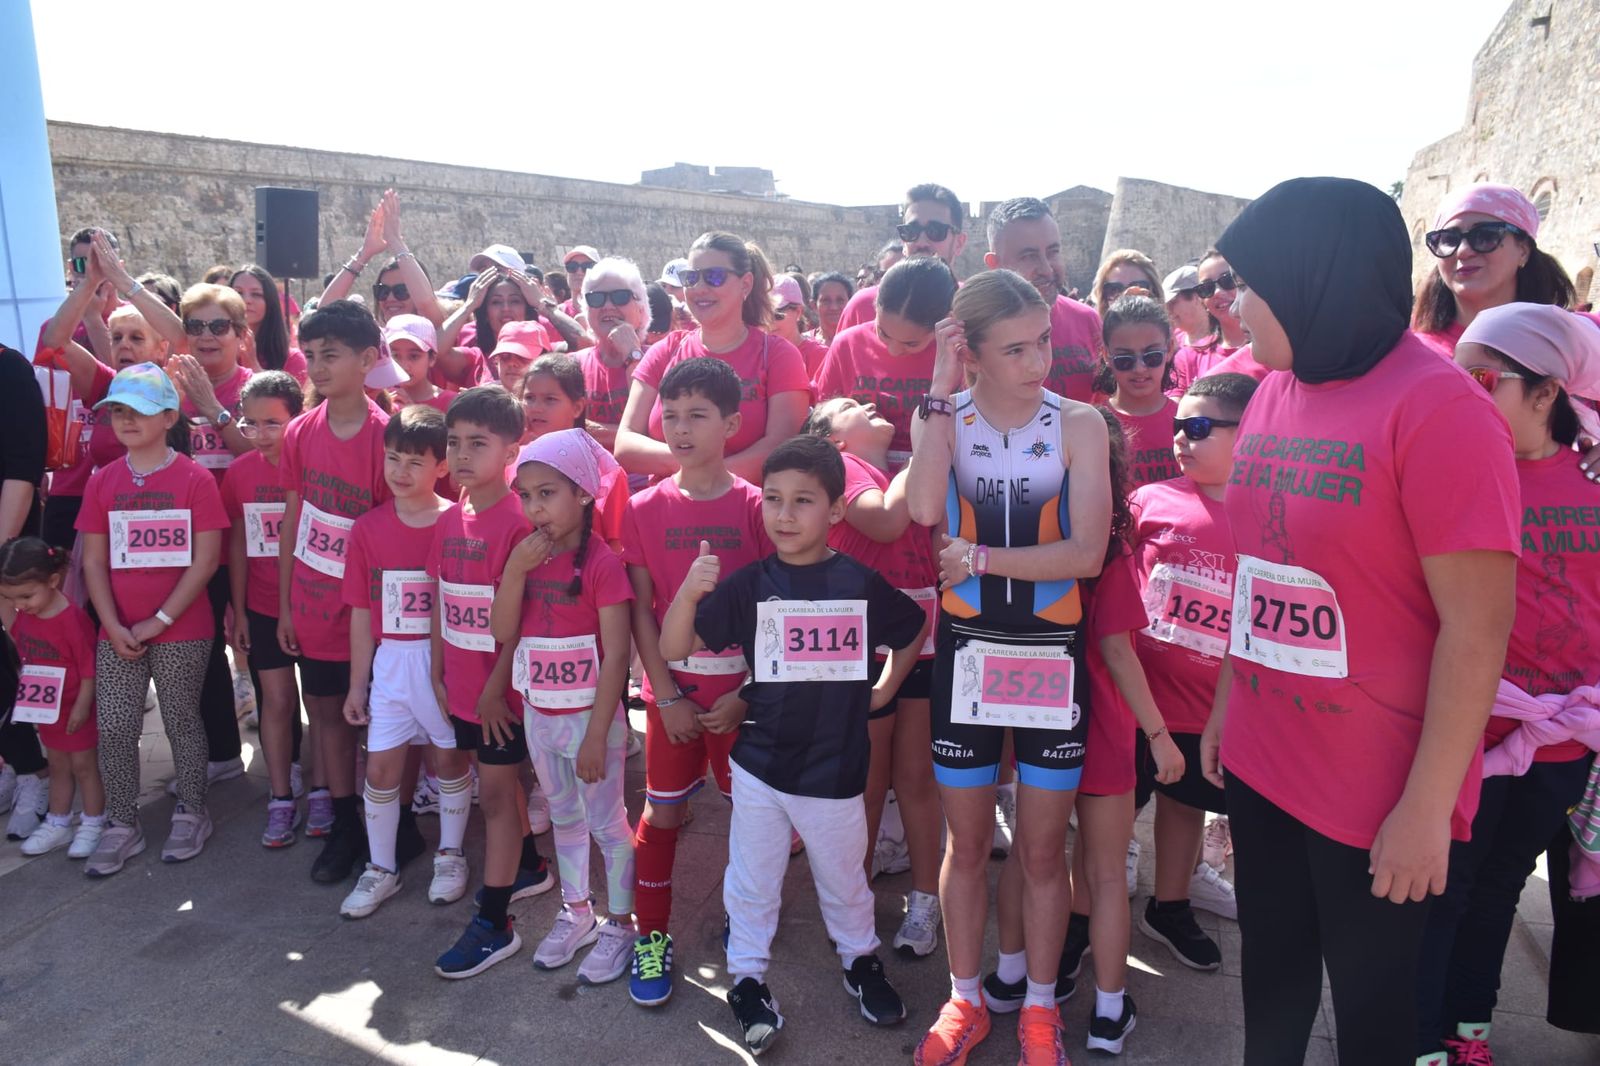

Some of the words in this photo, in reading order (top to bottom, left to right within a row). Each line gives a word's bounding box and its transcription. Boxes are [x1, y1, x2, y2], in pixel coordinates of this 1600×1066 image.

[1261, 435, 1366, 472] CARRERA
[976, 477, 1030, 504] DAFNE
[1275, 467, 1363, 506] MUJER
[1522, 506, 1600, 528] ARRE
[129, 528, 186, 548] 2058
[308, 528, 351, 557] 234
[685, 526, 742, 537] CARRERA
[1254, 568, 1276, 581] CARRERA
[1277, 574, 1286, 583] DE
[1298, 578, 1322, 587] MUJER
[444, 602, 490, 629] 2345
[1168, 595, 1230, 633] 1625
[1253, 594, 1337, 640] 2750
[788, 627, 859, 652] 3114
[987, 648, 1018, 657] CARRERA
[531, 659, 593, 684] 2487
[986, 669, 1067, 700] 2529
